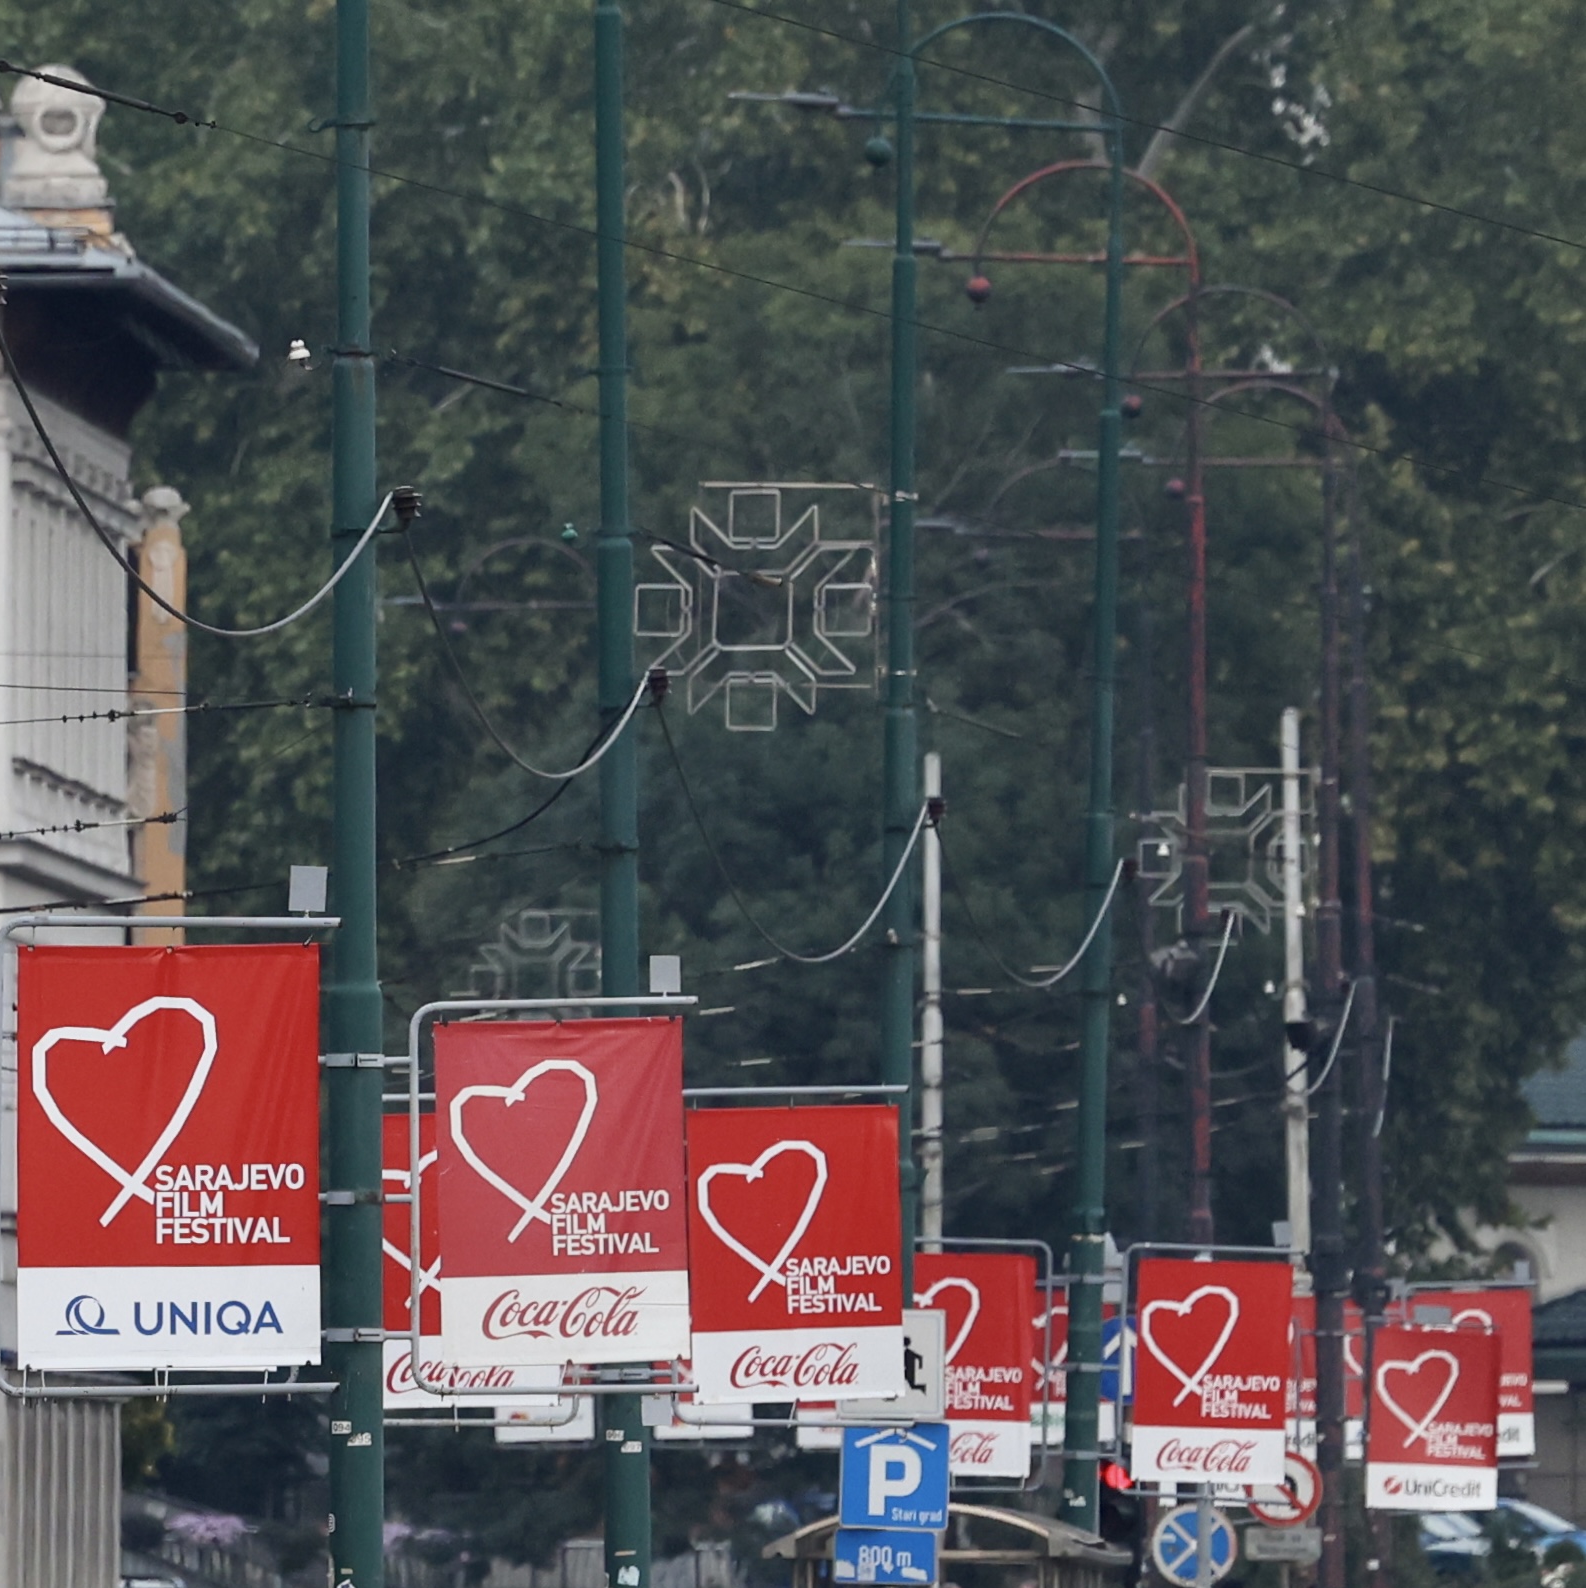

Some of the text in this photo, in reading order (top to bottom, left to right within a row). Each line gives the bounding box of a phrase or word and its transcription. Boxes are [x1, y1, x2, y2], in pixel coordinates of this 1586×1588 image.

[154, 1163, 305, 1191] SARAJEVO
[155, 1192, 224, 1218] FILM
[551, 1190, 670, 1214] SARAJEVO
[155, 1217, 291, 1245] FESTIVAL
[551, 1213, 606, 1235] FILM
[552, 1232, 660, 1257] FESTIVAL
[785, 1255, 891, 1277] SARAJEVO
[786, 1275, 835, 1295] FILM
[787, 1293, 883, 1314] FESTIVAL
[133, 1301, 283, 1336] UNIQA
[945, 1365, 1022, 1384] SARAJEVO
[1202, 1374, 1281, 1392] SARAJEVO
[945, 1381, 981, 1398] FILM
[1202, 1390, 1239, 1404] FILM
[945, 1395, 1015, 1412] FESTIVAL
[1200, 1403, 1272, 1420] FESTIVAL
[1428, 1421, 1493, 1438] SARAJEVO
[868, 1444, 922, 1516] P
[1405, 1479, 1482, 1498] UniCredit
[858, 1545, 912, 1567] 800 m
